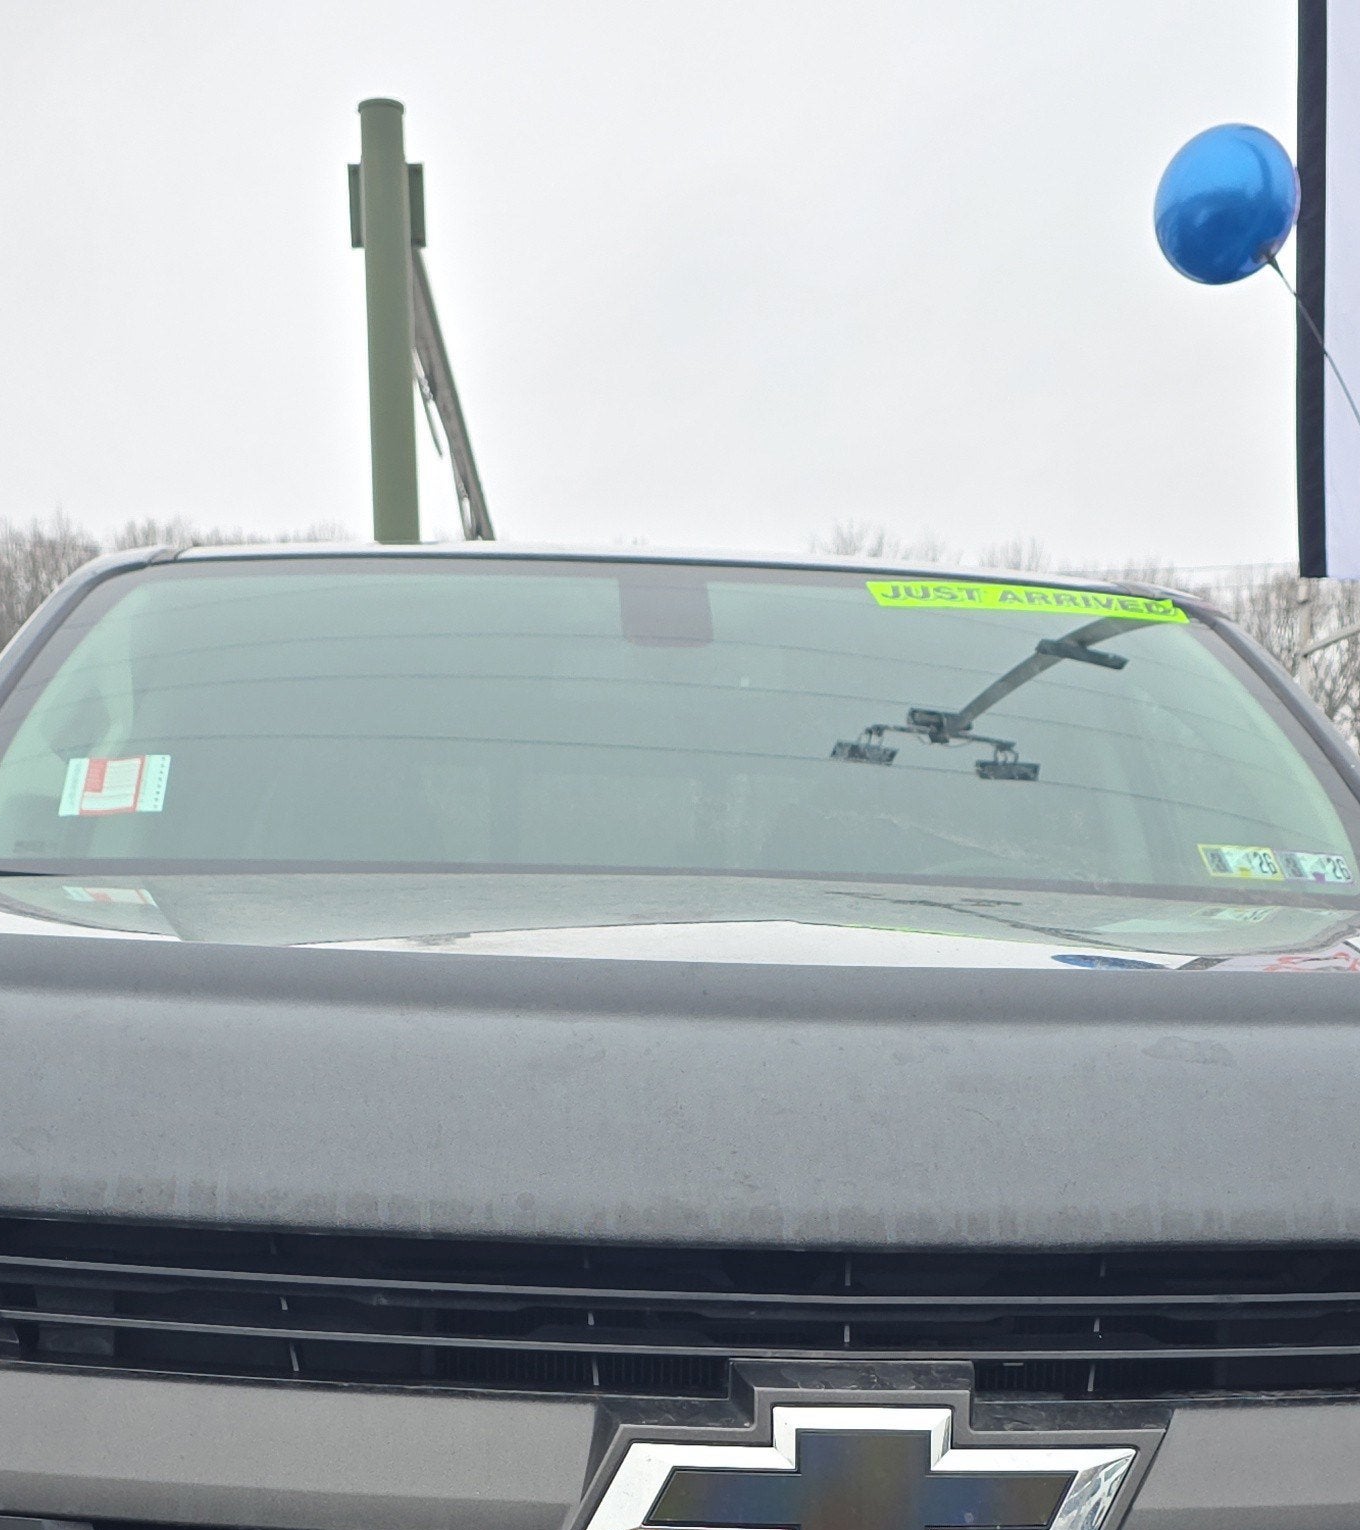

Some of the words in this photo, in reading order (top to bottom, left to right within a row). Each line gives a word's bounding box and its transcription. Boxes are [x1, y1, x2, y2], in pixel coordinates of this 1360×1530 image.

[881, 584, 981, 602] JUST
[998, 589, 1177, 616] ARRIVED
[1253, 851, 1278, 874] 26
[1326, 857, 1351, 880] 26
